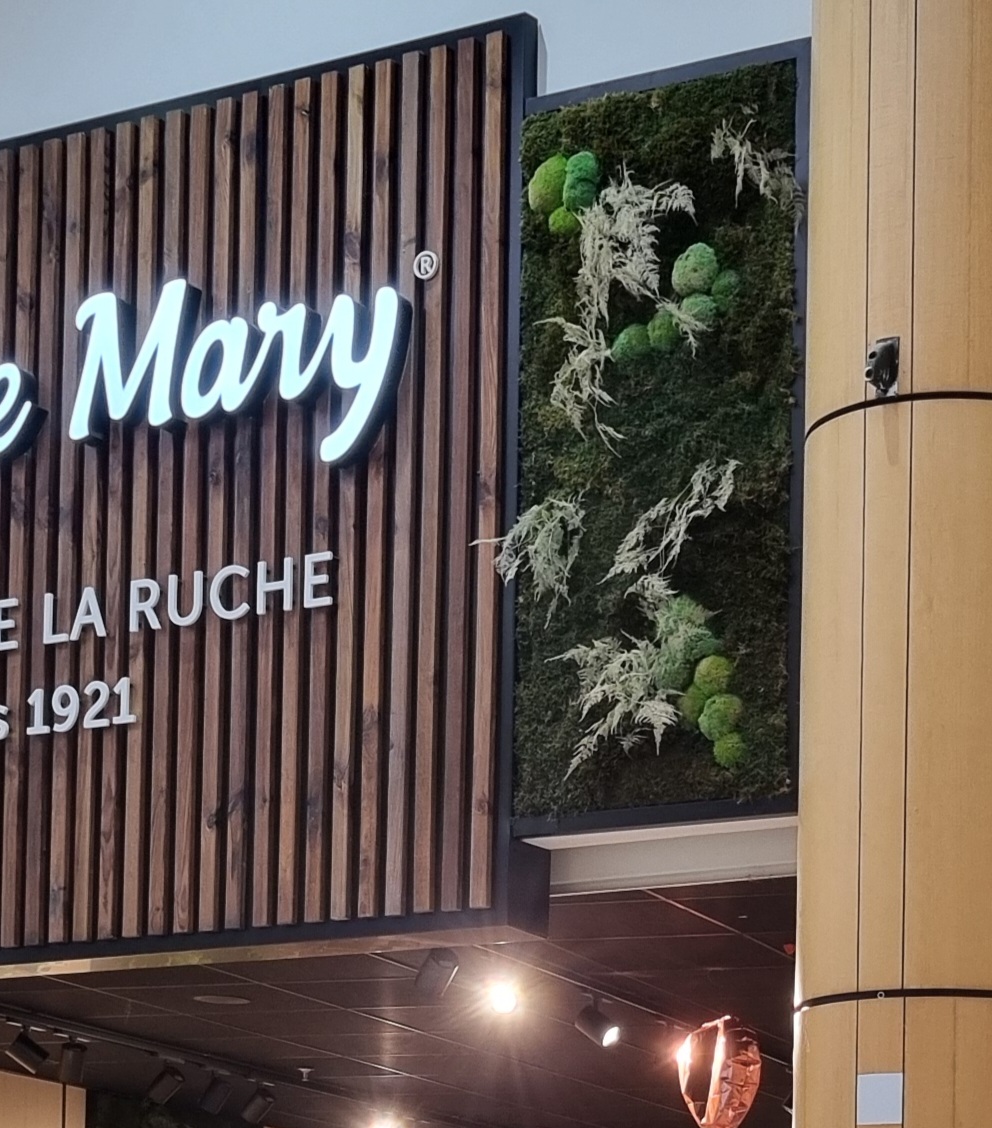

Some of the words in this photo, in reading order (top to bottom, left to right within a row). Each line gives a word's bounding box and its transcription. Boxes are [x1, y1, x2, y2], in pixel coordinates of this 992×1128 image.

[68, 277, 399, 465] Mary
[42, 585, 107, 646] LA
[128, 550, 334, 633] RUCHE
[26, 676, 137, 738] 1921
